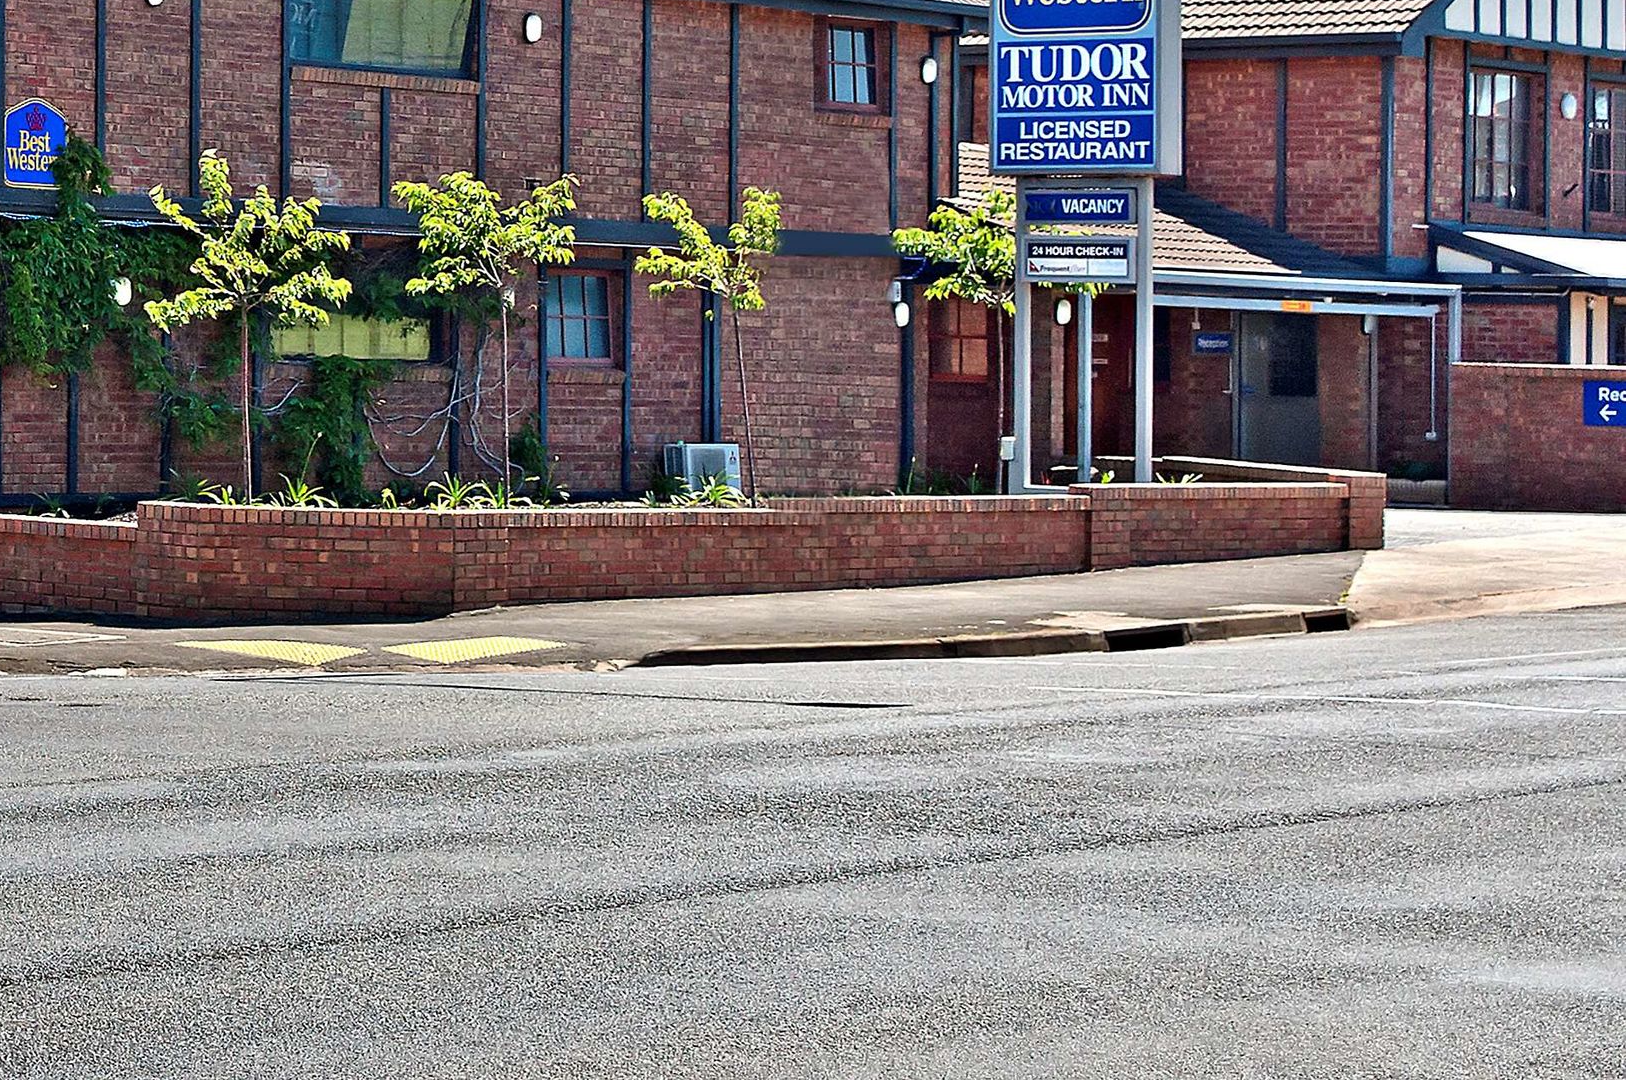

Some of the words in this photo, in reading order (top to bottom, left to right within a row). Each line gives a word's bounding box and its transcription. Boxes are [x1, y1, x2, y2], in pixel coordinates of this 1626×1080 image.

[1000, 43, 1151, 83] TUDOR
[1000, 84, 1096, 108] MOTOR
[1101, 82, 1151, 106] INN
[1019, 120, 1132, 140] LICENSED
[19, 129, 51, 152] Best
[1000, 140, 1151, 161] RESTAURANT
[1061, 198, 1125, 214] VACANCY
[1032, 246, 1044, 256] 24
[1045, 246, 1074, 256] HOUR
[1075, 246, 1124, 256] CHECK-IN
[1598, 386, 1626, 402] Rec
